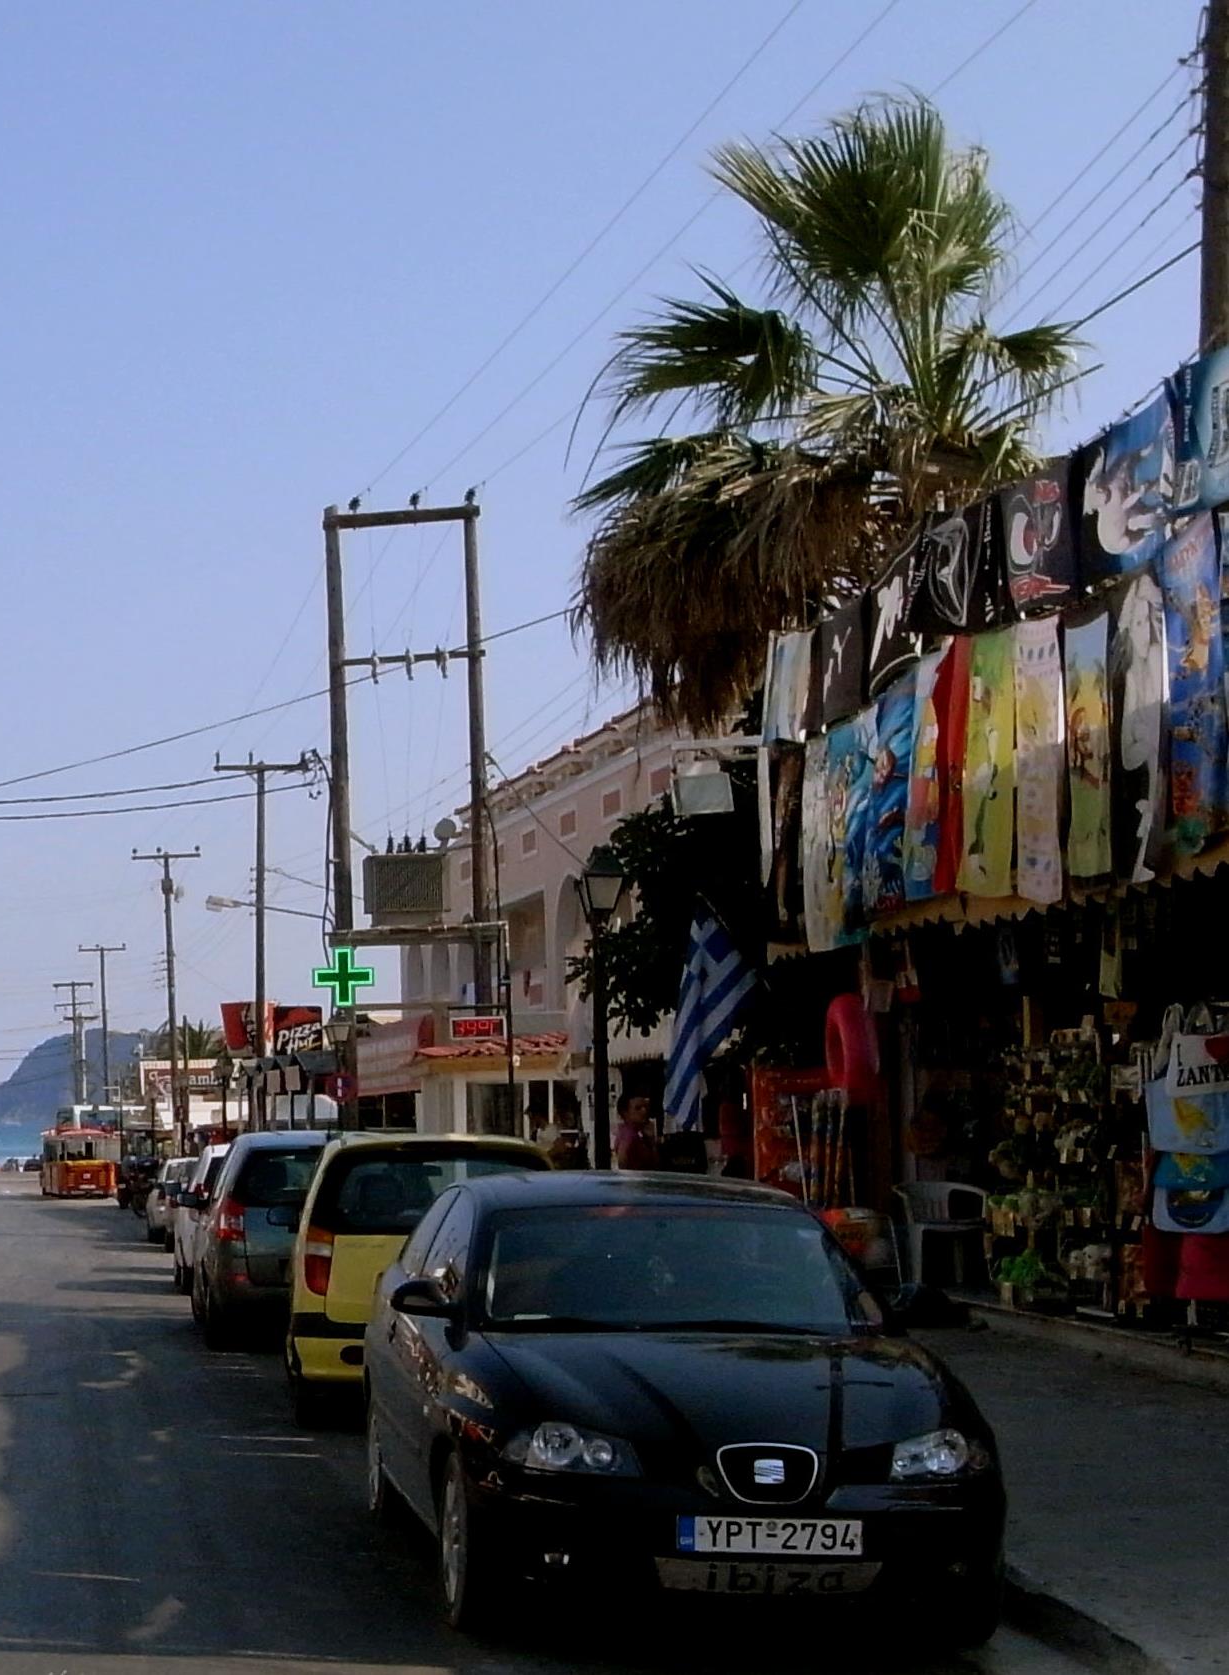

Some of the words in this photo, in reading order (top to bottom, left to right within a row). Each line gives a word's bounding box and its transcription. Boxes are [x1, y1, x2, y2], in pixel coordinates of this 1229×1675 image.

[277, 1021, 322, 1052] Pizza
[285, 1033, 319, 1055] Hut
[707, 1519, 857, 1551] YPT-2794
[706, 1563, 848, 1594] ibiza
